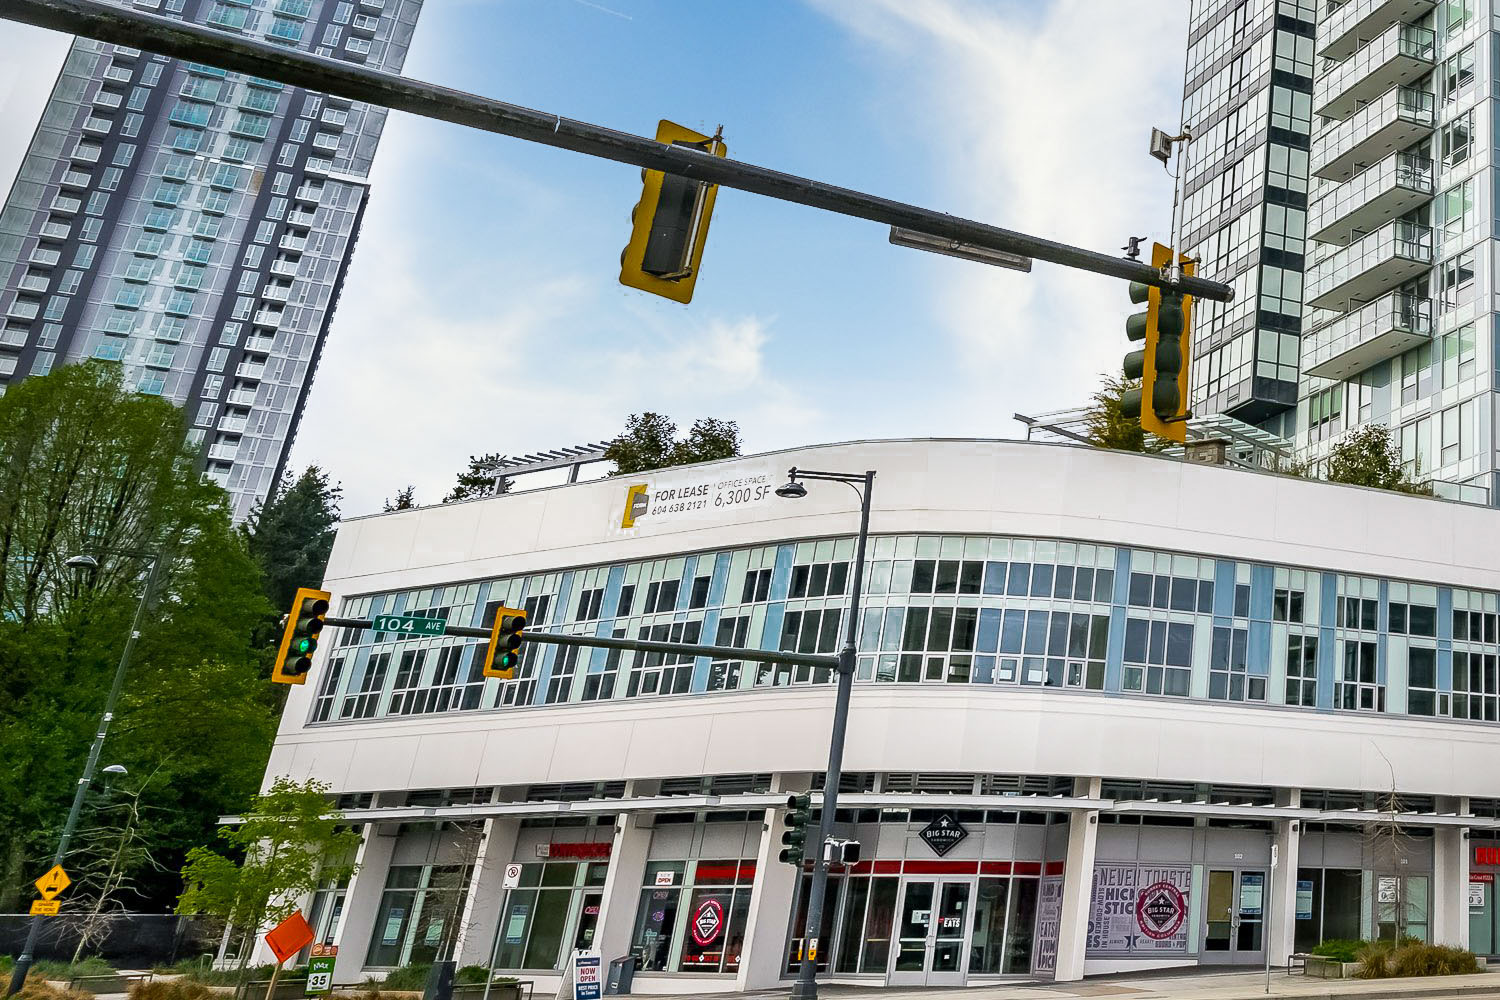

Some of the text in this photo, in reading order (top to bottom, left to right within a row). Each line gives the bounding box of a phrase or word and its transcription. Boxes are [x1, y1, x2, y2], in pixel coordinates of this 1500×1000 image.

[717, 475, 766, 490] OFFICE SPACE
[654, 484, 710, 503] FOR LEASE
[714, 484, 772, 508] 6,300 SF
[651, 505, 667, 516] 604
[668, 502, 685, 513] 638
[686, 499, 707, 511] 2121
[379, 618, 442, 632] 104 AVE
[926, 830, 961, 838] BIG STAR
[1147, 906, 1175, 914] BIG STAR
[943, 920, 960, 928] EATS
[1102, 916, 1111, 939] HOUSE
[580, 967, 596, 975] NOW
[311, 975, 327, 986] 35
[580, 975, 596, 983] OPEN
